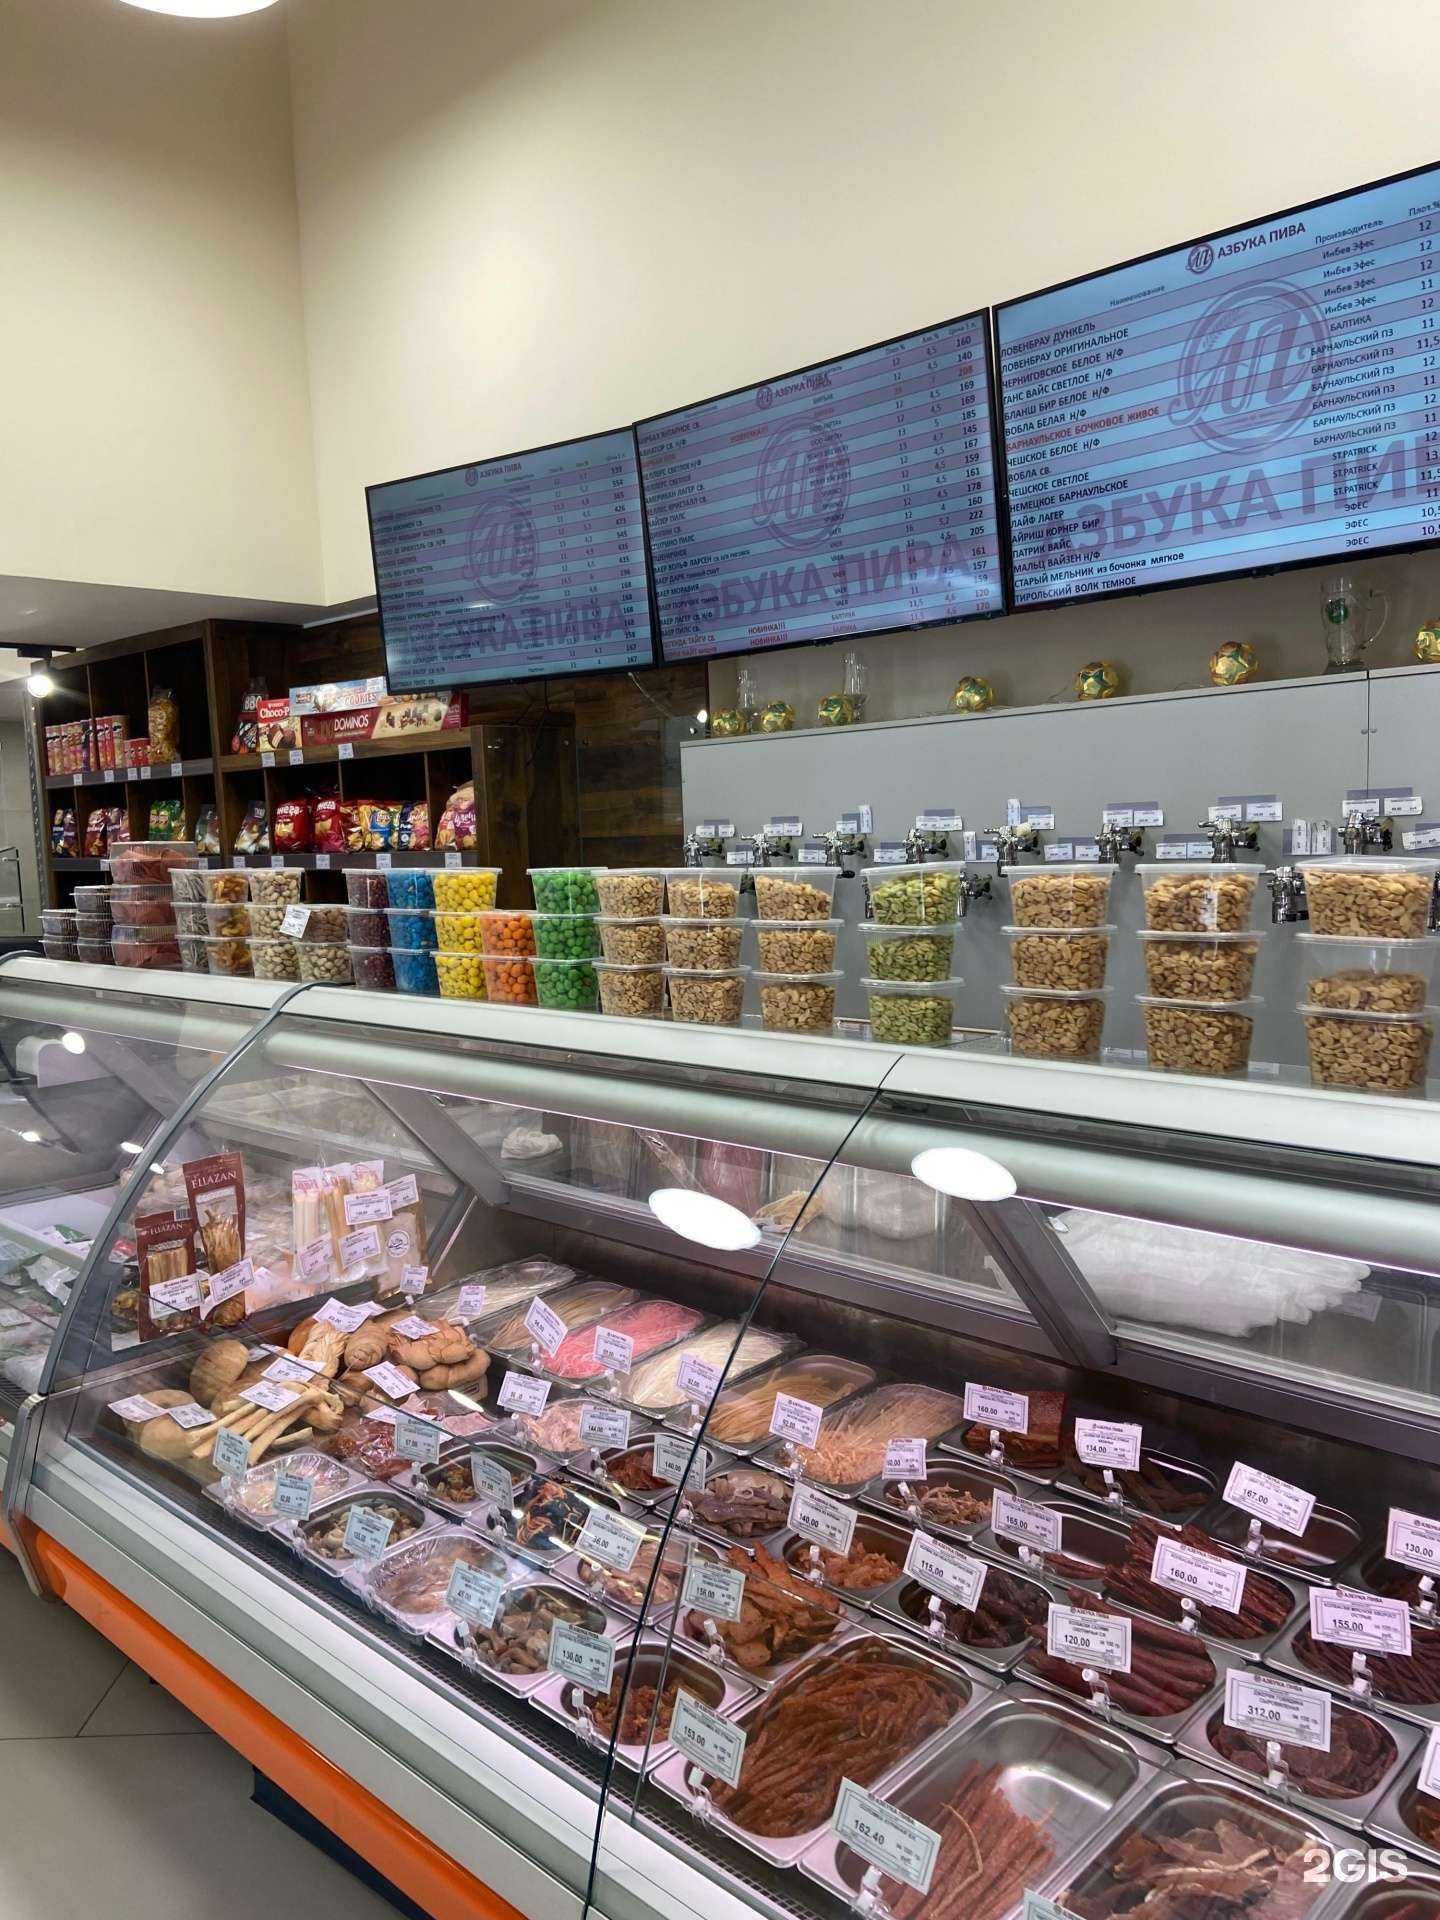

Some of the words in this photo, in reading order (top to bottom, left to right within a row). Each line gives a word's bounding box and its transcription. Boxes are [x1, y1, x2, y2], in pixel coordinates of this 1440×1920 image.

[1418, 220, 1432, 231] 12
[1217, 236, 1267, 259] АЗБУКА
[1269, 222, 1306, 243] ПИВА
[1352, 238, 1375, 252] Эфес
[1420, 240, 1432, 251] 12
[1353, 258, 1375, 271] Эфес
[1421, 260, 1433, 271] 12
[1354, 276, 1376, 290] Эфес
[1421, 279, 1434, 290] 11
[1355, 295, 1376, 308] Эфес
[1421, 298, 1434, 309] 12
[1330, 315, 1372, 331] БАЛТИКА
[1422, 318, 1434, 329] 11
[1053, 322, 1096, 343] ДУНКЕЛЬ
[1002, 352, 1051, 372] ЛОВЕНБРАУ
[1054, 328, 1129, 358] ОРИГИНАЛЬНОЕ
[1310, 330, 1379, 356] БАРНАУЛЬСКИЙ
[957, 352, 972, 362] 140
[1311, 349, 1380, 374] БАРНАУЛЬСКИЙ
[1423, 356, 1435, 367] 12
[1002, 363, 1067, 388] ЧЕРНИГОВСКОЕ
[1072, 354, 1101, 369] БЕЛОЕ
[1106, 348, 1124, 361] Н/Ф
[1025, 385, 1050, 399] ВАЙС
[1051, 375, 1090, 391] СВЕТЛОЕ
[1095, 368, 1113, 382] Н/Ф
[1312, 367, 1381, 392] БАРНАУЛЬСКИЙ
[1423, 375, 1435, 386] 11
[1004, 405, 1037, 421] БЛАНШ
[1039, 399, 1057, 412] БИР
[1058, 391, 1087, 406] БЕЛОЕ
[1092, 386, 1110, 399] Н/Ф
[1312, 385, 1381, 410] БАРНАУЛЬСКИЙ
[1424, 394, 1436, 404] 12
[1005, 422, 1035, 436] ВОБЛА
[1037, 415, 1066, 429] БЕЛАЯ
[1069, 409, 1087, 422] Н/Ф
[1313, 403, 1381, 428] БАРНАУЛЬСКИЙ
[1424, 413, 1436, 423] 11
[1006, 429, 1072, 452] БАРНАУЛЬСКОЕ
[1075, 415, 1124, 435] БОЧКОВОЕ
[1127, 407, 1160, 421] ЖИВОЕ
[1313, 422, 1382, 446] БАРНАУЛЬСКИЙ
[964, 439, 978, 449] 167
[1425, 432, 1437, 442] 12
[1007, 450, 1047, 467] ЧЕШСКОЕ
[1050, 443, 1078, 458] БЕЛОЕ
[1083, 438, 1100, 451] Н/Ф
[1425, 451, 1438, 461] 13
[966, 468, 980, 477] 161
[1008, 469, 1037, 483] ВОБЛА
[1009, 481, 1049, 498] ЧЕШСКОЕ
[1051, 472, 1089, 488] СВЕТЛОЕ
[1010, 495, 1056, 513] НЕМЕЦКОЕ
[1059, 480, 1129, 503] БАРНАУЛЬСКОЕ
[1427, 488, 1438, 498] 11
[1344, 501, 1368, 512] ЭФЕС
[969, 510, 983, 520] 222
[1011, 516, 1036, 528] ЛАЙФ
[1038, 510, 1065, 524] ЛАГЕР
[970, 526, 984, 536] 205
[1012, 529, 1044, 544] АЙРИШ
[1046, 522, 1079, 537] КОРНЕР
[1082, 518, 1100, 530] БИР
[1345, 519, 1369, 529] ЭФЕС
[1013, 543, 1046, 558] ПАТРИК
[1048, 539, 1071, 552] ВАЙС
[1346, 537, 1369, 547] ЭФЕС
[972, 547, 986, 556] 161
[973, 561, 986, 570] 157
[1014, 558, 1046, 574] МАЛЬЦ
[1047, 552, 1081, 566] ВАЙЗЕН
[1084, 551, 1100, 562] Н/Ф
[1015, 575, 1048, 588] СТАРЫЙ
[1050, 569, 1094, 583] МЕЛЬНИК
[1097, 566, 1107, 574] из
[1109, 558, 1146, 571] бочонка
[1150, 552, 1184, 565] мягкое
[1015, 585, 1072, 603] ТИРОЛЬСКИЙ
[1075, 582, 1099, 593] ВОЛК
[1102, 576, 1136, 589] ТЕМНОЕ
[260, 708, 289, 718] Choco-P
[334, 714, 369, 732] DOMINOS
